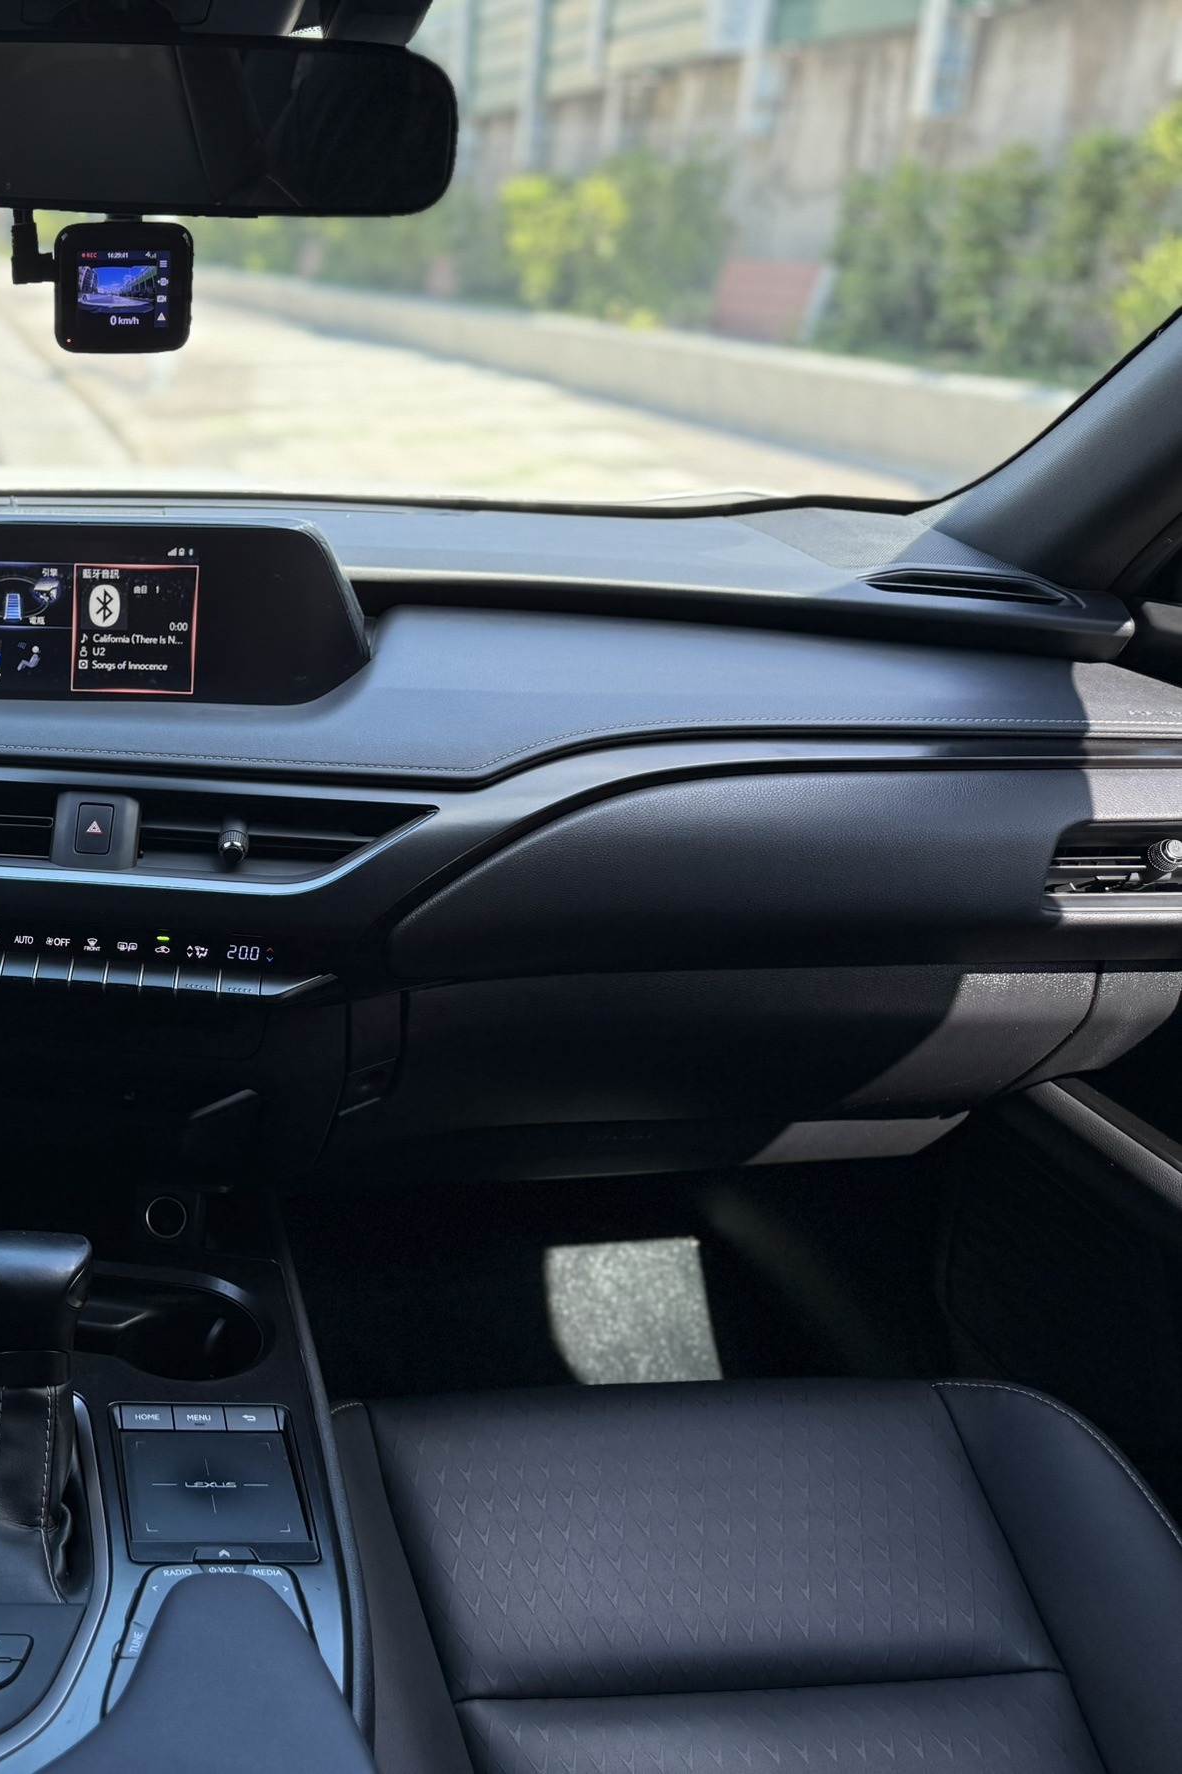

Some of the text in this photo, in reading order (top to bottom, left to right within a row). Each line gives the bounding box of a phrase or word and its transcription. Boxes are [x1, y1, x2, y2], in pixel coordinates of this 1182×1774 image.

[109, 315, 140, 326] 0 km/h
[169, 621, 189, 632] 0:00
[92, 633, 130, 644] California
[131, 633, 158, 645] (There
[92, 646, 106, 657] U2
[91, 660, 168, 672] Songs of Innocence
[13, 935, 34, 945] AUTO
[53, 937, 71, 947] OFF
[226, 944, 260, 961] 20.0
[134, 1413, 160, 1421] HOME
[186, 1413, 211, 1421] MENU
[163, 1567, 192, 1577] RADIO
[218, 1566, 238, 1574] VOL
[252, 1568, 283, 1577] MEDIA
[129, 1630, 144, 1654] TUNE
